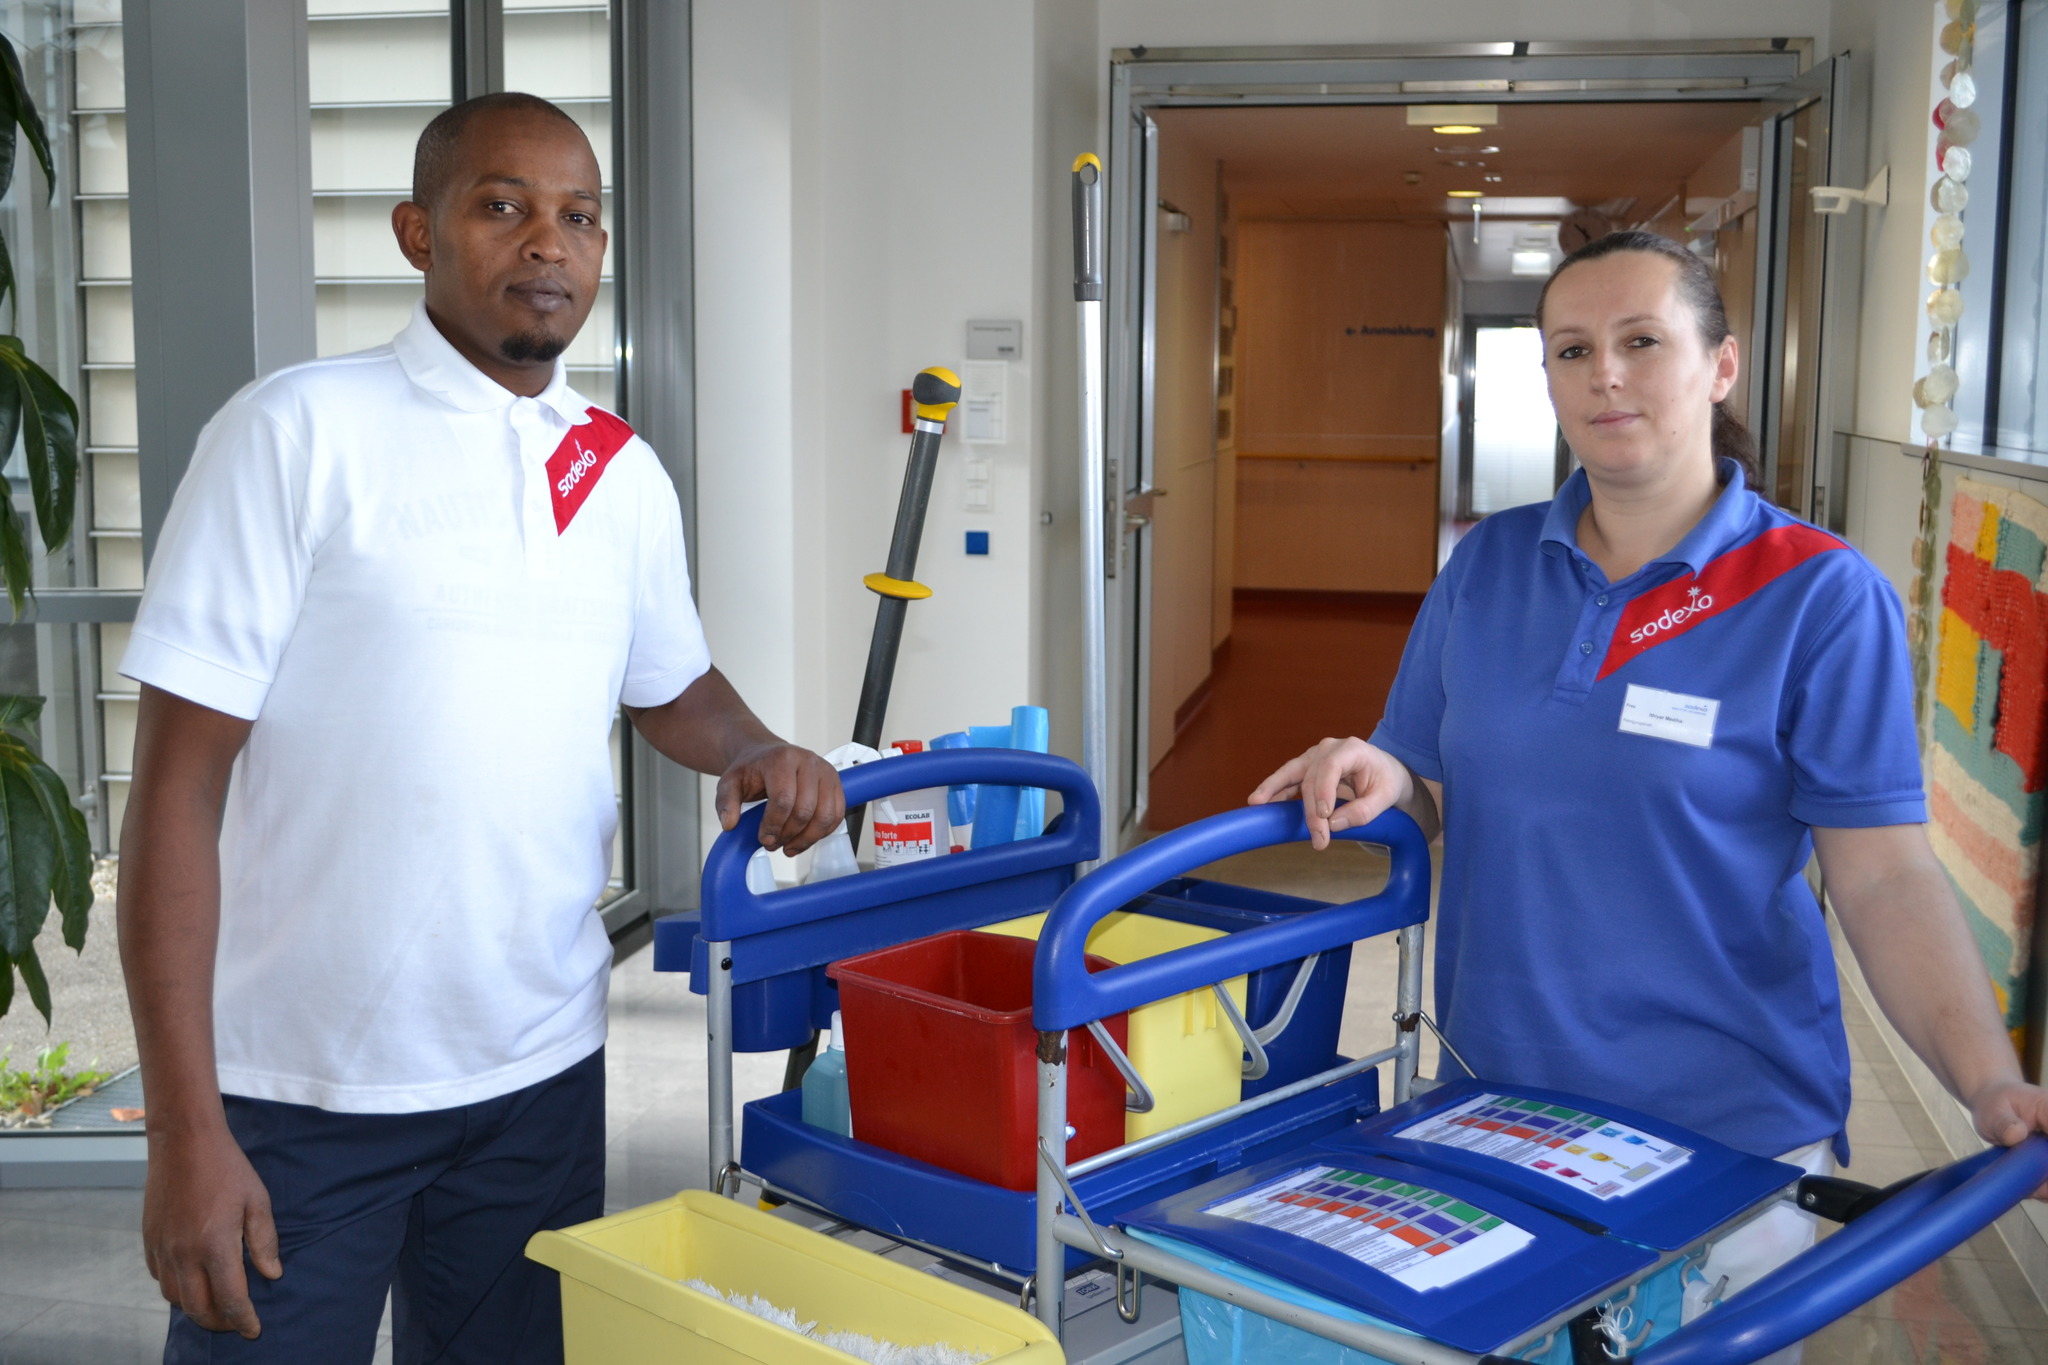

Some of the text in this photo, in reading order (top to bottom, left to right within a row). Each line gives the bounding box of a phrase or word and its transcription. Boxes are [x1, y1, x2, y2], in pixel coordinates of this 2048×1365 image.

[1360, 325, 1436, 338] Anmeldung
[557, 439, 597, 498] sodexo
[1630, 587, 1713, 643] sodexo
[881, 831, 898, 840] forte
